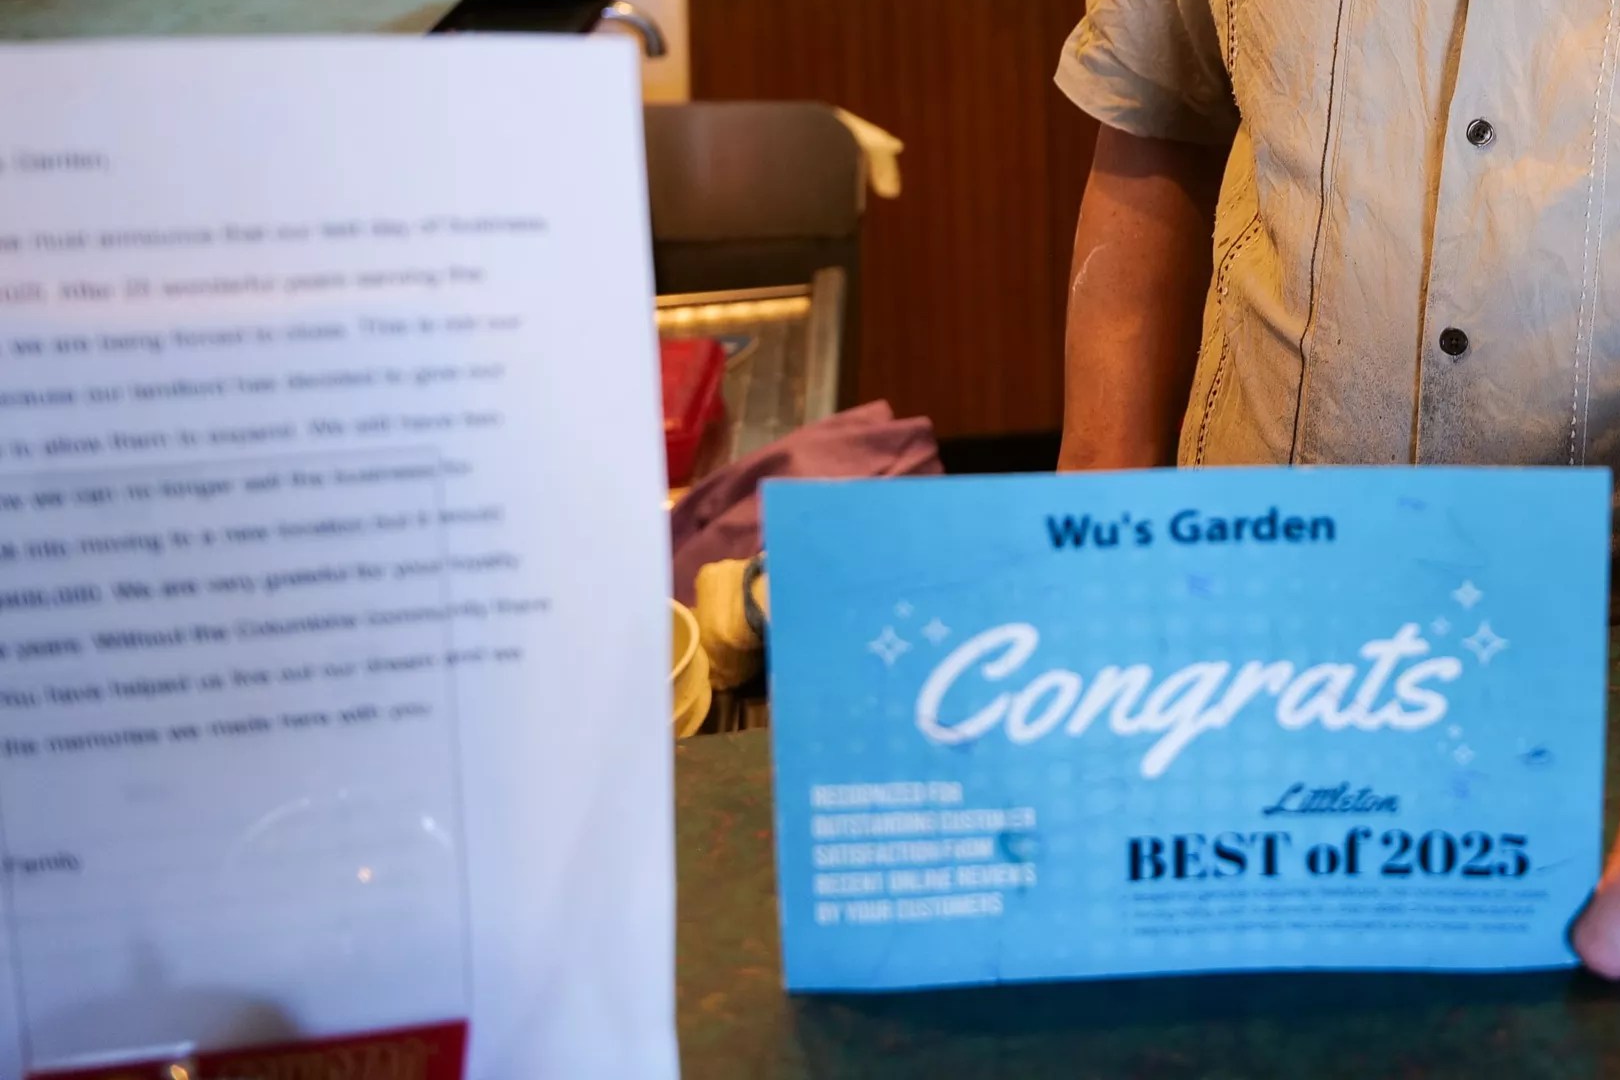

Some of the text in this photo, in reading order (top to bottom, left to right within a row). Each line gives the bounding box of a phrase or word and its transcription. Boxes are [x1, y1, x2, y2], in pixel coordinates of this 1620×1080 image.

[1045, 506, 1337, 550] Wu's Garden
[915, 622, 1462, 779] Congrats
[1262, 782, 1399, 816] Littleton
[1126, 830, 1531, 883] BEST of 2025
